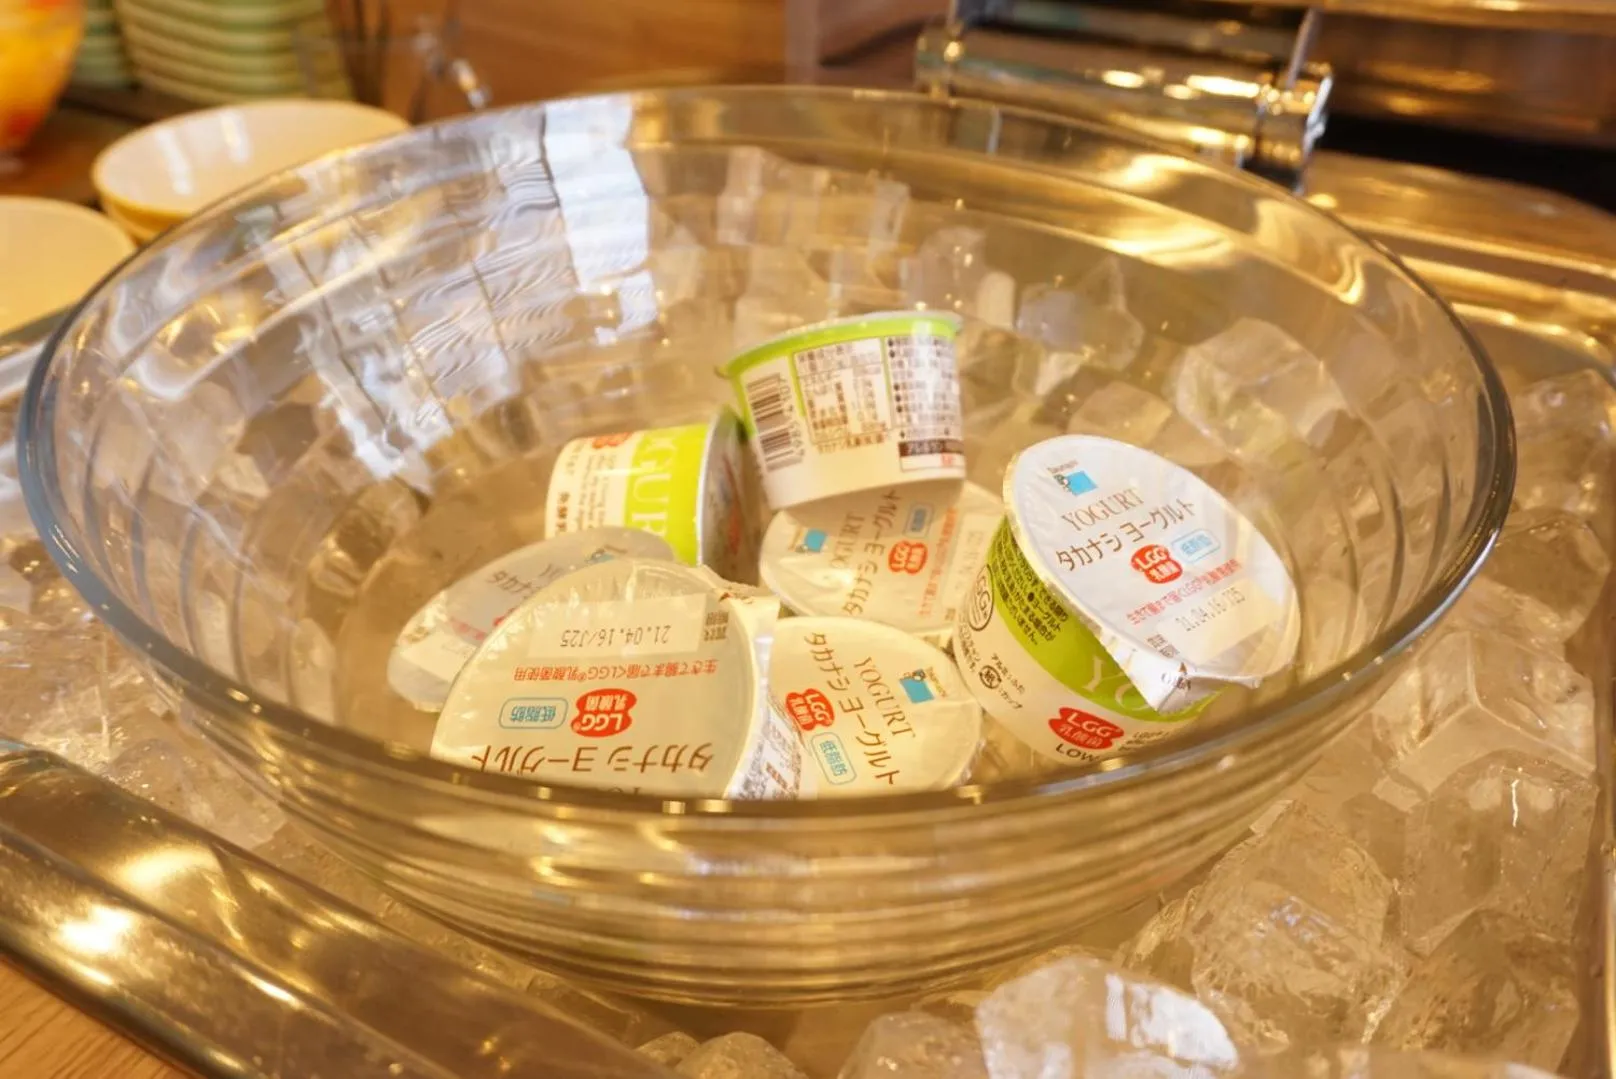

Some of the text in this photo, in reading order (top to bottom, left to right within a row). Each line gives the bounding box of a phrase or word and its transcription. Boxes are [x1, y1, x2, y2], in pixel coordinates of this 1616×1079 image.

[1060, 487, 1145, 532] YOGURT
[841, 489, 903, 616] タカナシ ヨーグルト
[1056, 498, 1195, 571] タカナシ ヨーグルト
[560, 625, 672, 648] 21.04.16/J25
[510, 705, 557, 723] 低脂肪
[586, 694, 627, 712] 乳酸菌
[804, 632, 900, 785] タカナシ ヨーグルト
[853, 656, 916, 738] YOGURT
[472, 742, 714, 777] タカナシ ヨーグルト
